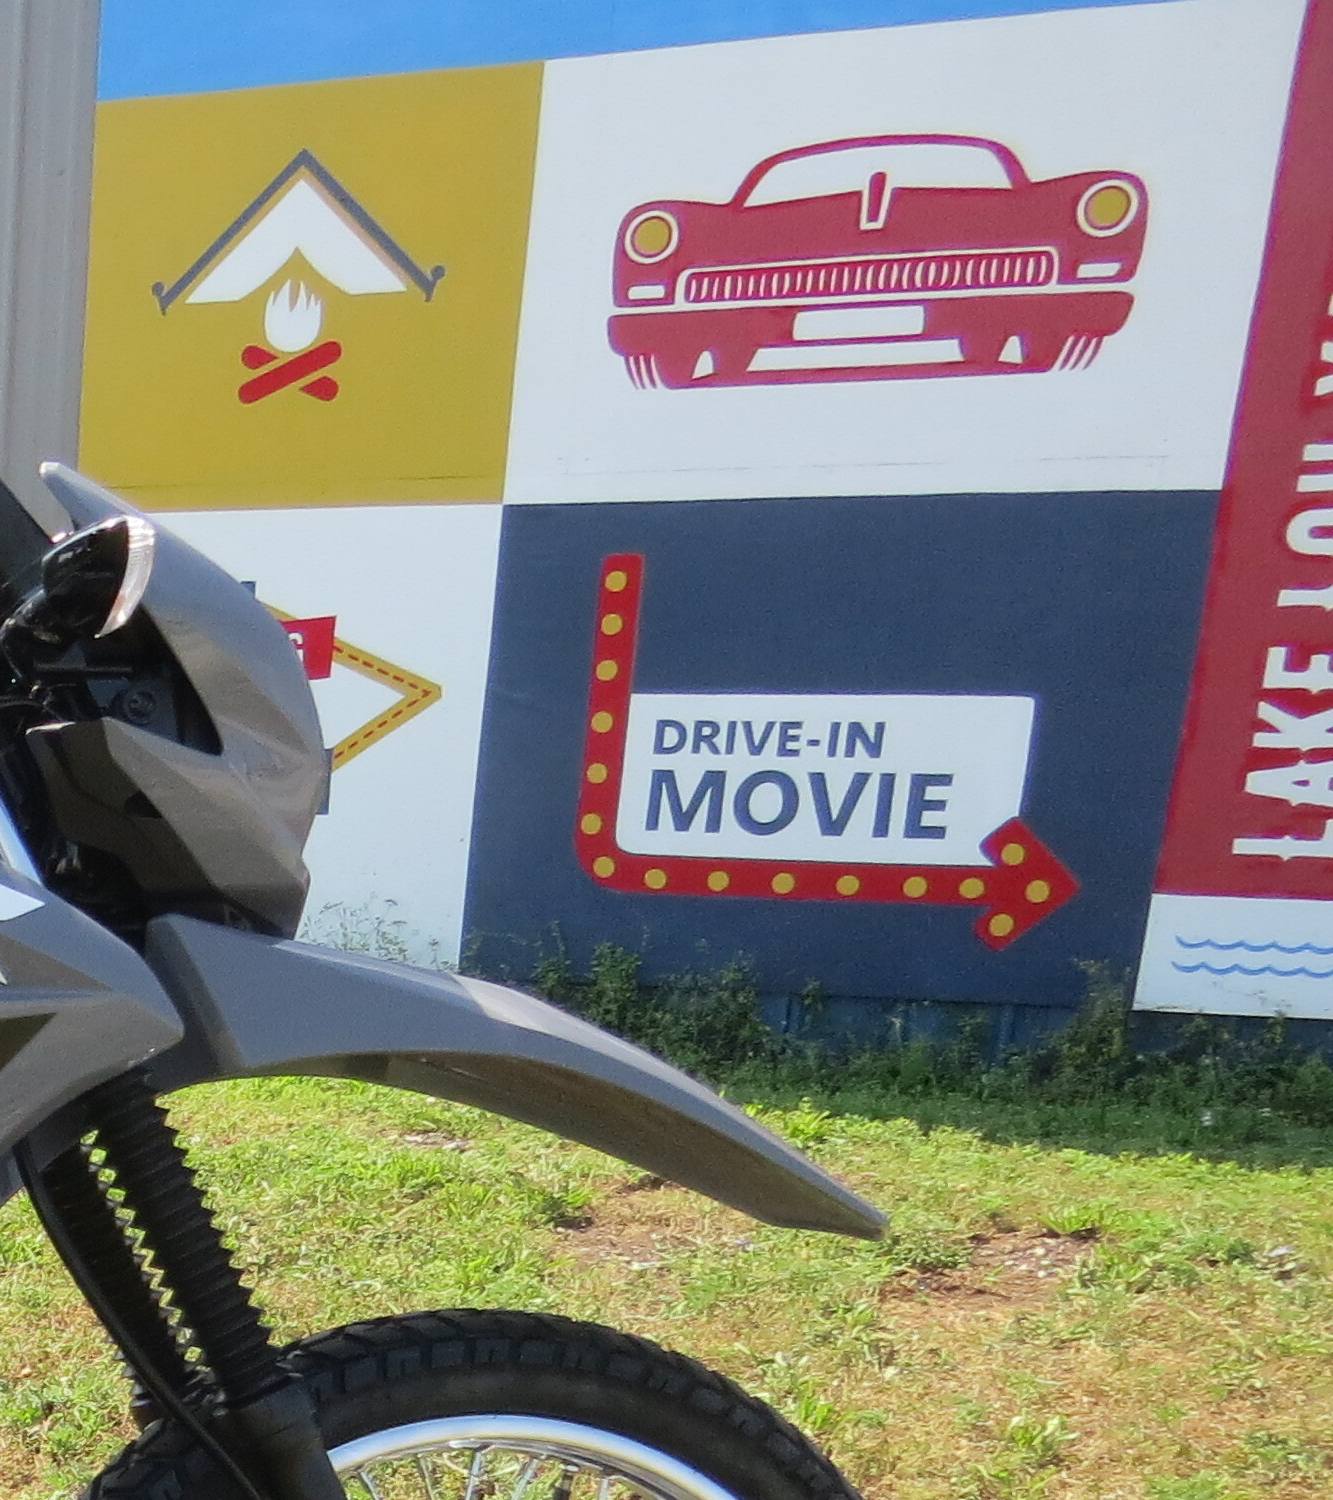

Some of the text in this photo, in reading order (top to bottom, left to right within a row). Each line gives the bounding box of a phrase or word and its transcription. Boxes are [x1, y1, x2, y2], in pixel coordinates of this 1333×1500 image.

[653, 719, 886, 758] DRIVE-IN
[1233, 646, 1333, 861] LAKE
[645, 769, 954, 840] MOVIE
